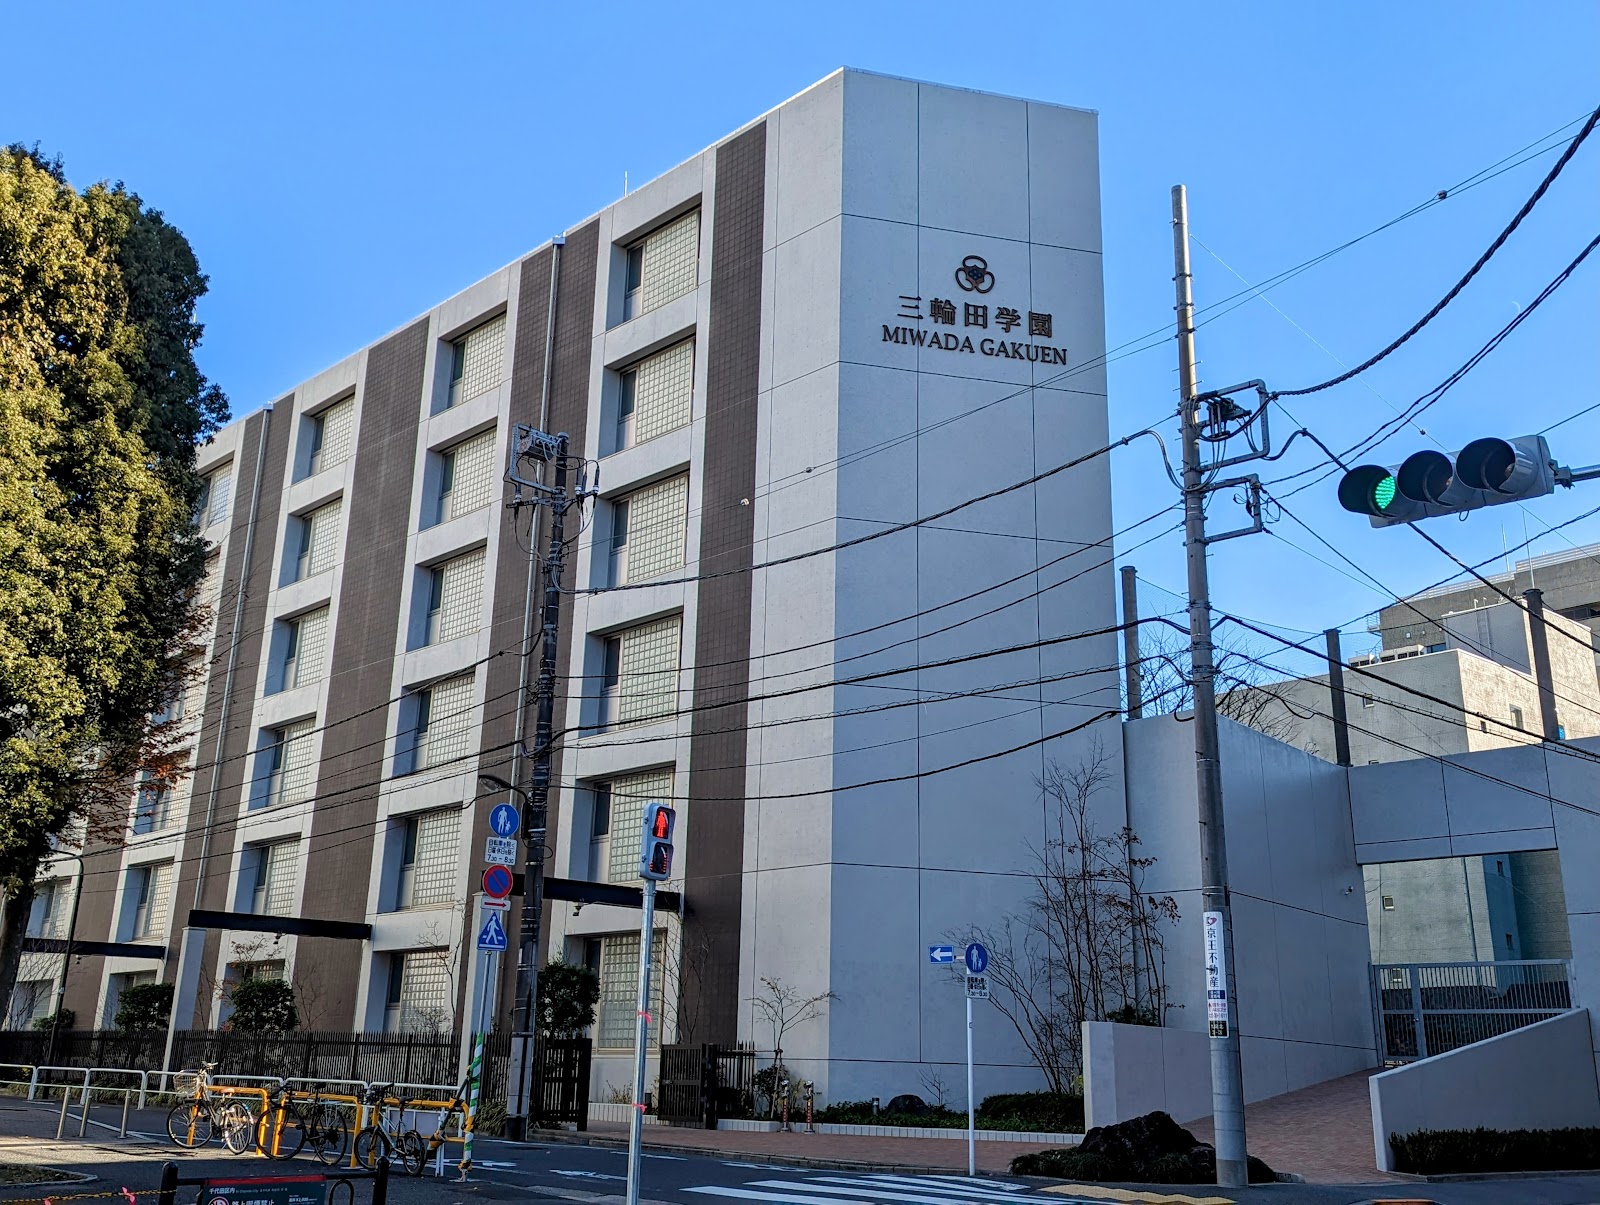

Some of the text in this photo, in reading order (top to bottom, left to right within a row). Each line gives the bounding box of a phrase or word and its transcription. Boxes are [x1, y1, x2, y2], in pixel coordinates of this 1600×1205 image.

[897, 295, 1053, 338] 三輪田学園
[882, 325, 1067, 365] MIWADA GAKUEN
[1207, 928, 1220, 988] 京王不動産
